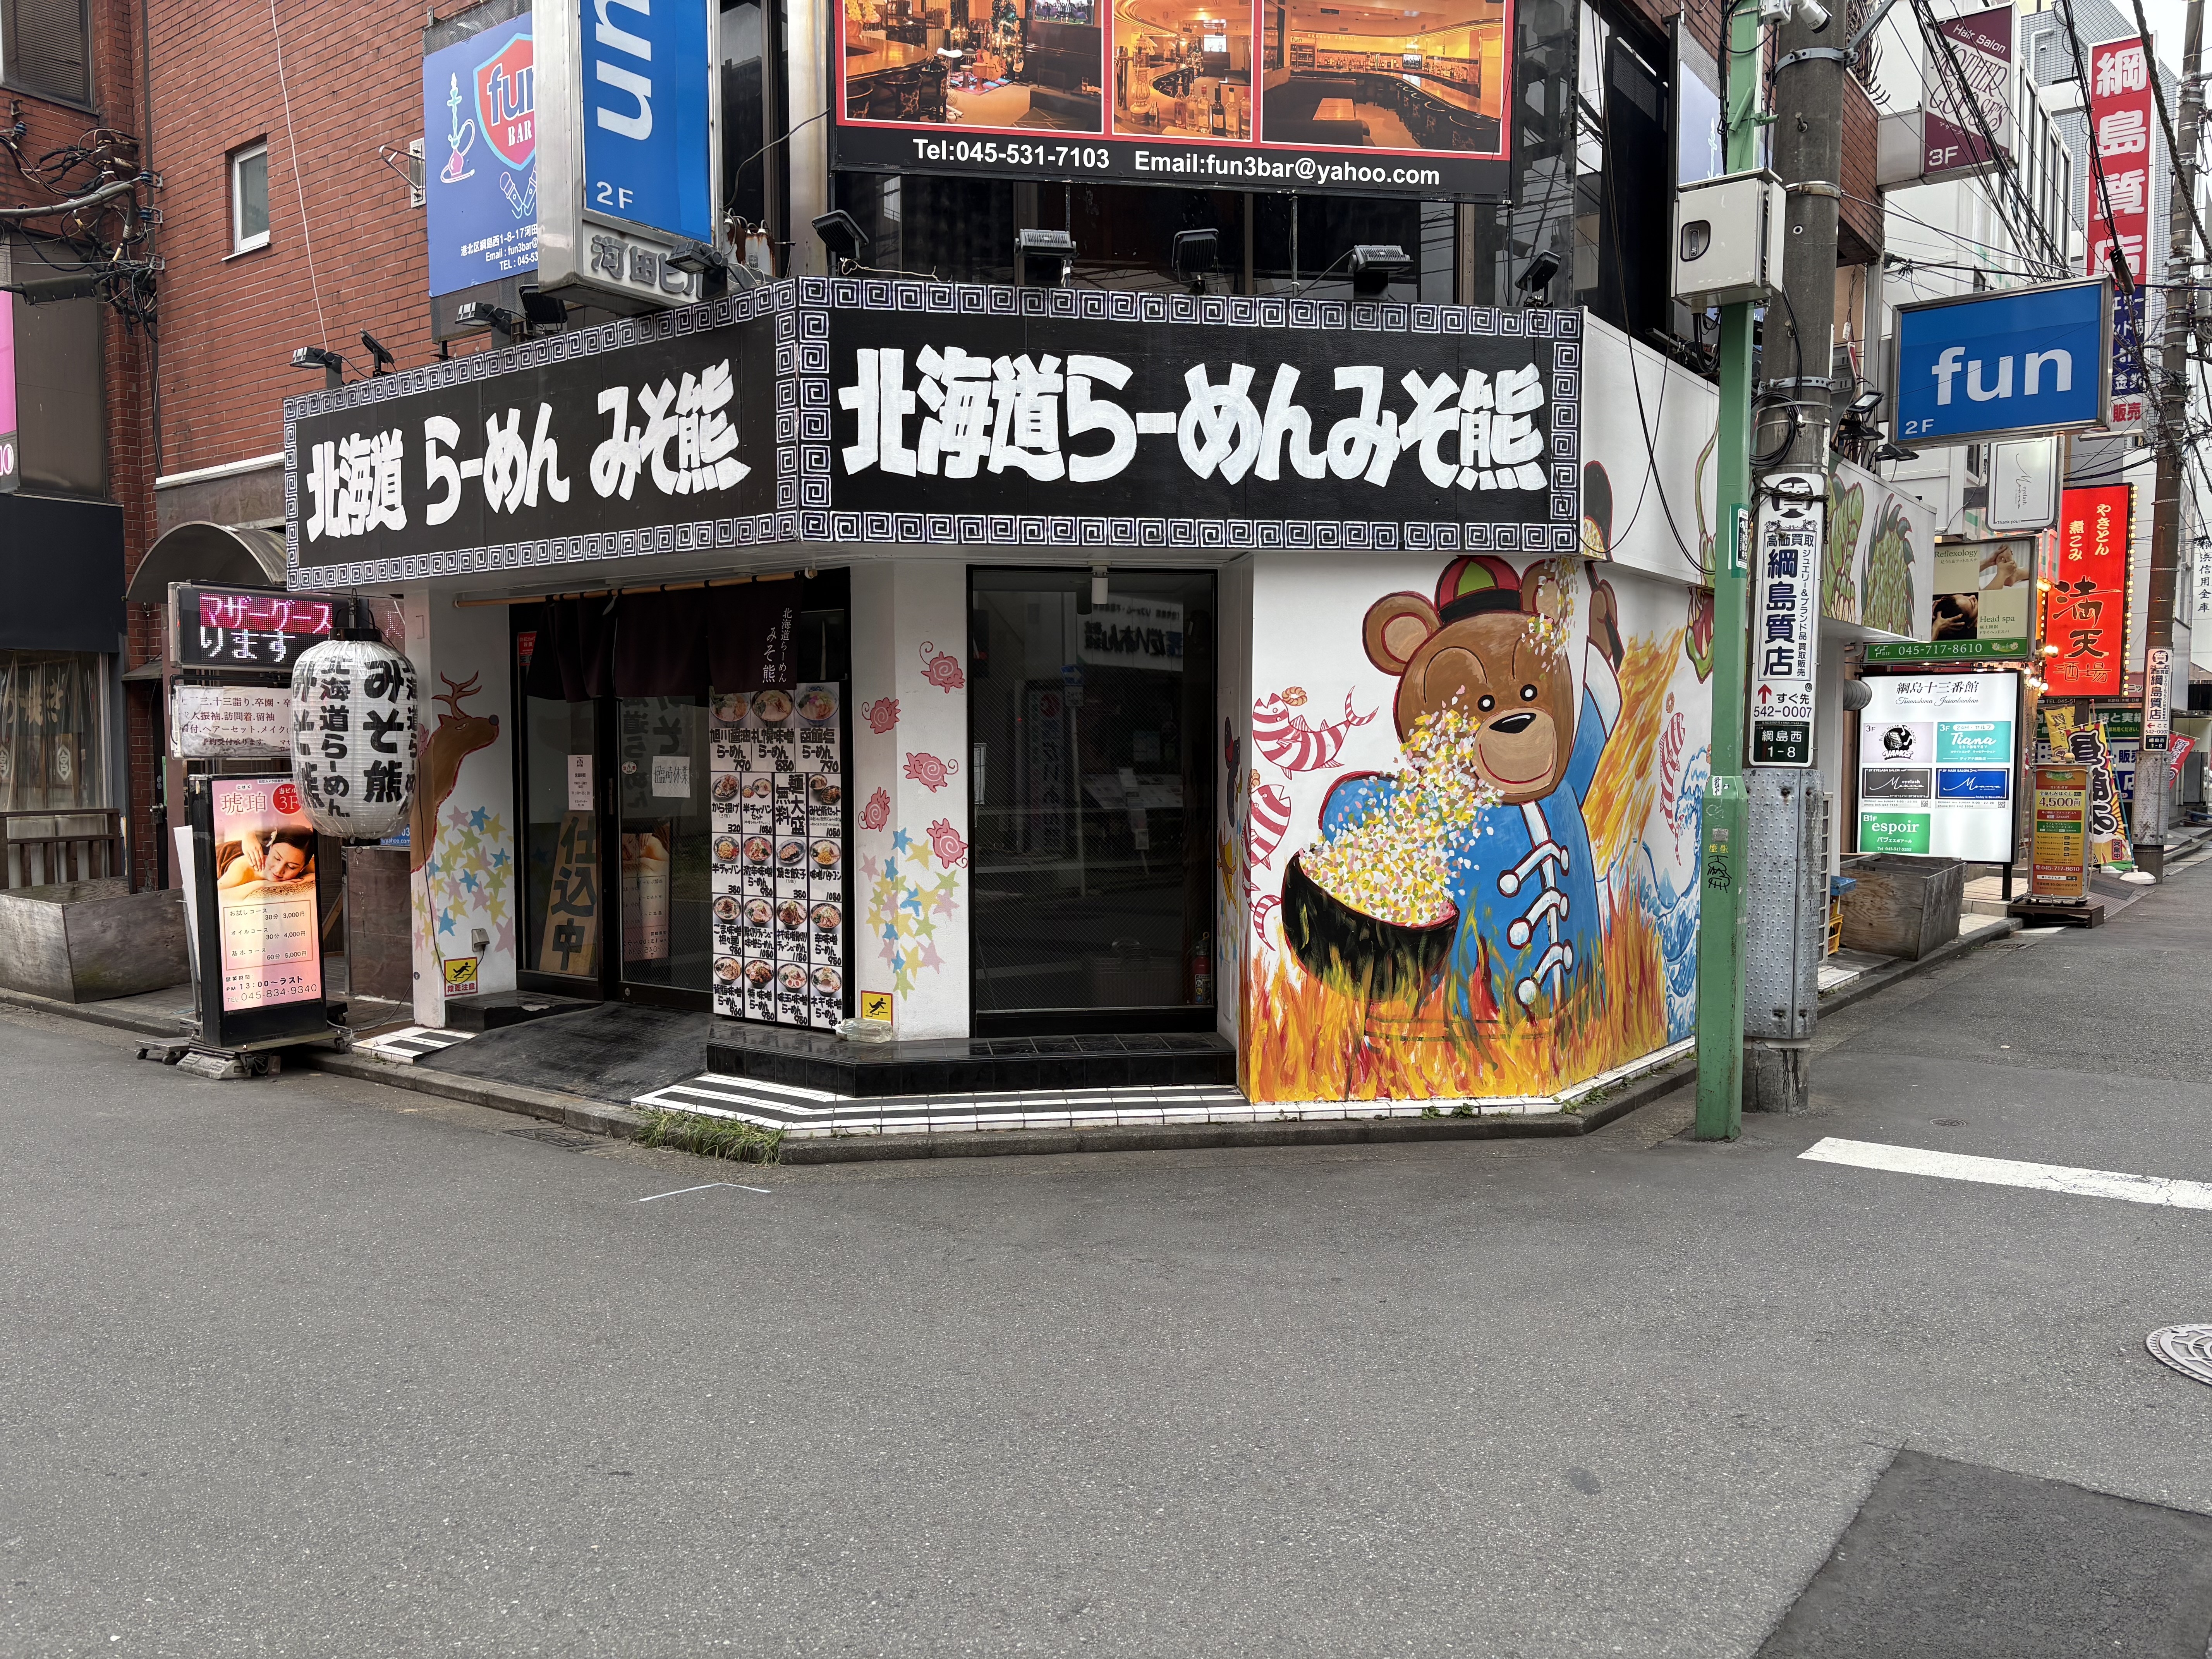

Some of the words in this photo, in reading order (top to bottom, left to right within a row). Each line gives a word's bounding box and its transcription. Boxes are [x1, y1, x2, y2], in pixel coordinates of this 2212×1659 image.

[1953, 24, 1975, 40] Hair
[1976, 34, 2006, 53] Salon
[508, 120, 532, 147] BAR
[913, 138, 1110, 170] Tel:045-531-7103
[1929, 146, 1958, 166] 3F
[1135, 150, 1440, 186] Email:fun3bar@yahoo.com
[2094, 46, 2148, 283] 綱島質店
[597, 181, 634, 209] 2F
[1932, 346, 2072, 405] fun
[841, 344, 1549, 491] 北海道らーめんみそ熊
[1906, 419, 1934, 434] 2F
[306, 428, 407, 542] 北海道
[424, 399, 571, 527] らーめん
[589, 357, 751, 503] みそ熊
[2095, 503, 2112, 556] やきとん
[1767, 534, 1814, 548] 高価買取
[2068, 520, 2085, 561] 煮こみ
[200, 596, 333, 634] マザーグース
[1763, 549, 1798, 677] 綱島質店
[200, 625, 296, 662] ります
[778, 608, 792, 682] 北海道らーめん
[1898, 643, 1982, 656] 045-717-8610
[762, 627, 777, 683] みそ熊
[2053, 662, 2112, 683] 酒場
[1896, 681, 1979, 694] 綱島十三番館
[1778, 693, 1809, 705] すぐ先
[2150, 675, 2164, 720] 綱島質店
[1753, 706, 1812, 718] 542-0007
[319, 657, 350, 817] 北海道らーめん
[363, 659, 405, 803] みそ熊
[1762, 730, 1802, 742] 綱島西
[1951, 732, 1997, 745] Tiana
[717, 745, 746, 759] らーめん
[758, 745, 789, 759] らーめん
[802, 745, 834, 759] らーめん
[1767, 746, 1796, 757] 1-8
[1882, 749, 1914, 758] VAMOS
[733, 759, 751, 771] 790
[775, 759, 794, 772] 880
[820, 759, 839, 773] 790
[655, 765, 689, 784] 臨時休業
[221, 792, 266, 814] 琥珀
[279, 796, 300, 811] 3F
[712, 803, 740, 814] から揚げ
[776, 784, 791, 826] 無料
[788, 774, 805, 835] 麺大盛
[2039, 797, 2080, 807] 4,500円
[743, 804, 772, 814] 半チャーハン
[809, 805, 842, 817] みそ熊セット
[727, 823, 740, 833] 320
[759, 825, 772, 834] 1080
[826, 828, 841, 837] 1080
[1872, 820, 1920, 835] espoir
[712, 863, 741, 875] 半チャーハン
[743, 865, 773, 878] 激辛味噌
[777, 867, 806, 880] 焼き餃子
[728, 884, 741, 894] 380
[748, 877, 768, 888] らーめん
[551, 816, 597, 971] 仕込中
[760, 888, 773, 897] 980
[793, 889, 806, 899] 380
[826, 891, 841, 902] 1080
[230, 908, 267, 917] お試しコース
[231, 927, 268, 936] オイルコース
[714, 924, 742, 937] ごま味噌
[744, 939, 774, 950] 味噌らーめん
[814, 933, 838, 945] 辛味噌
[232, 948, 266, 957] 基本コース
[285, 950, 307, 958] 5,000円
[729, 945, 742, 955] 980
[759, 948, 774, 959] 1080
[815, 945, 836, 956] らーめん
[793, 952, 807, 962] 1180
[828, 955, 842, 965] 980
[241, 984, 317, 1001] 045-834-9340
[447, 983, 475, 993] 段差注意
[718, 996, 737, 1008] らーめん
[749, 1000, 769, 1012] らーめん
[810, 997, 842, 1010] ネギ味噌
[762, 1011, 775, 1021] 980
[781, 1005, 802, 1016] らーめん
[816, 1008, 837, 1020] らーめん
[794, 1015, 808, 1025] 980
